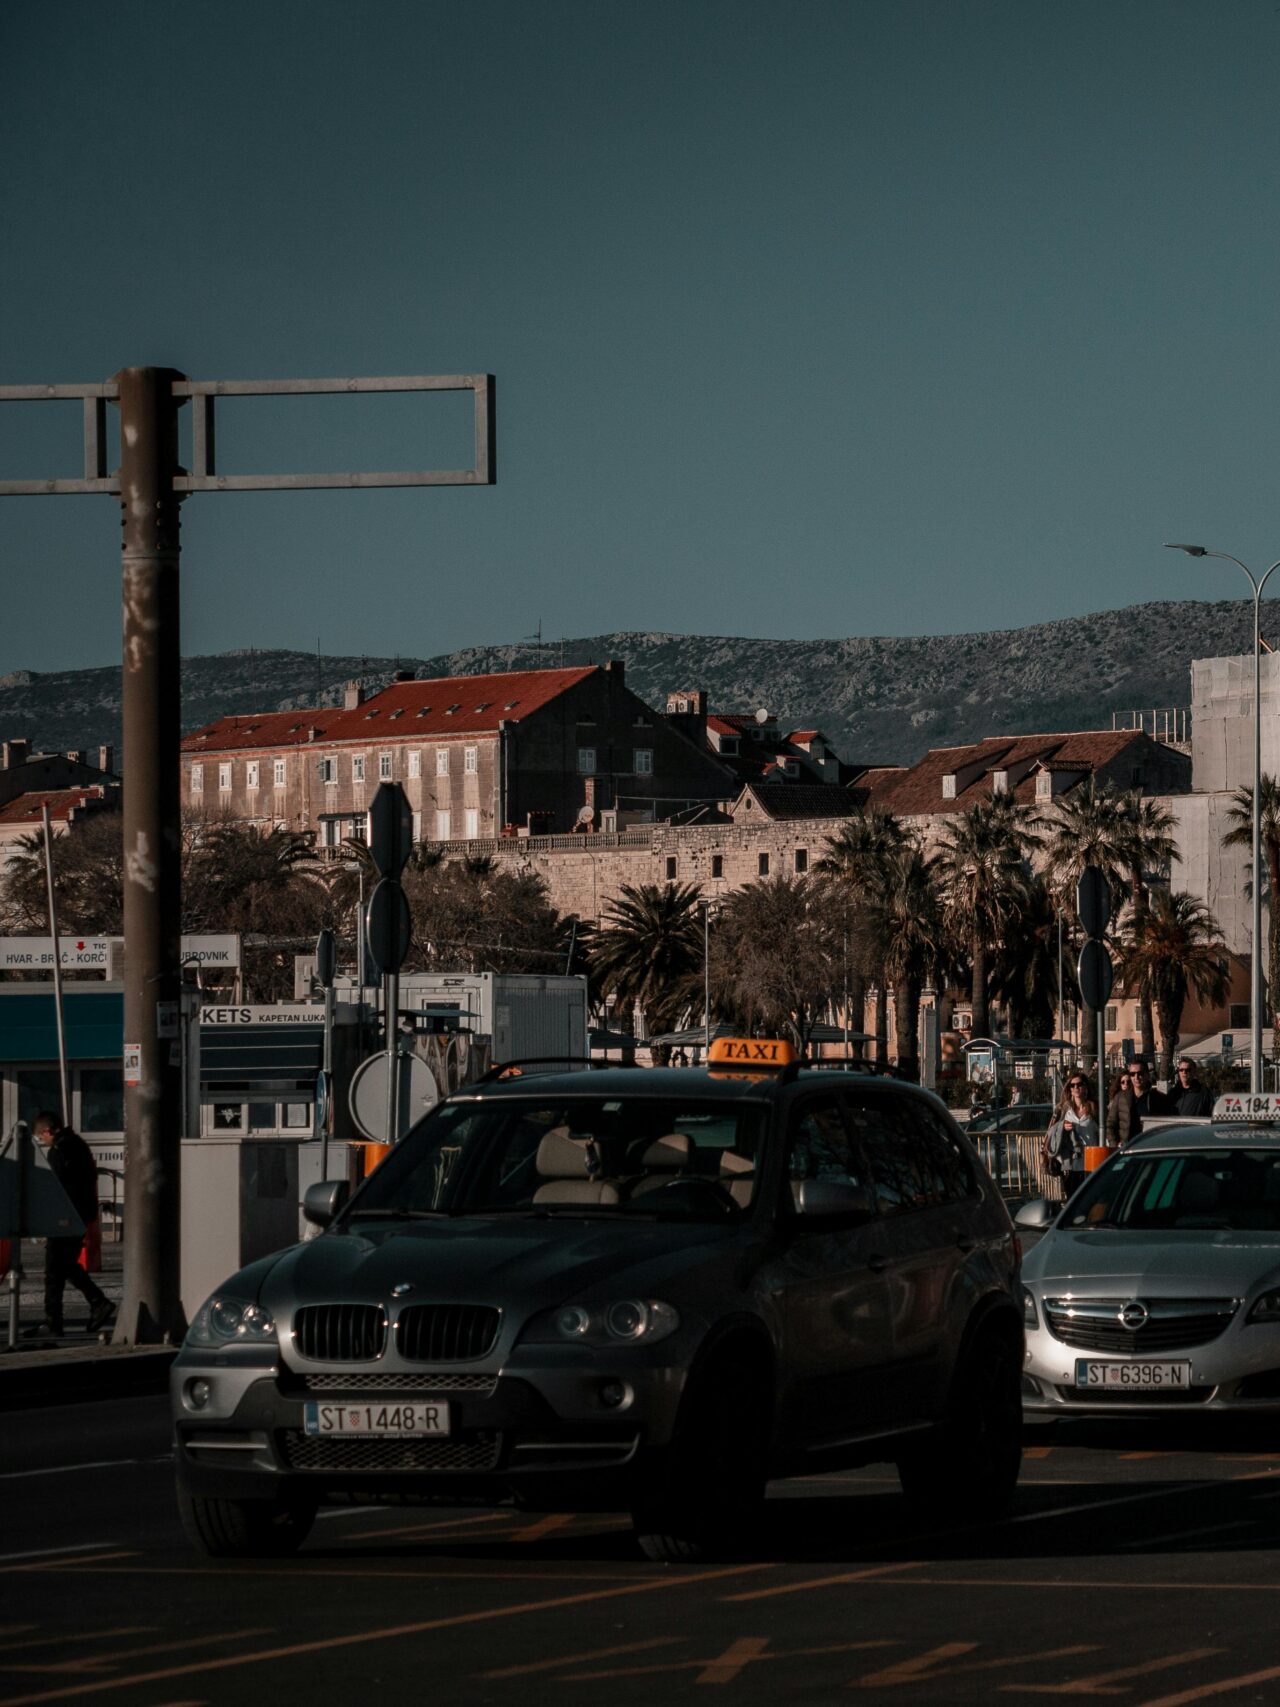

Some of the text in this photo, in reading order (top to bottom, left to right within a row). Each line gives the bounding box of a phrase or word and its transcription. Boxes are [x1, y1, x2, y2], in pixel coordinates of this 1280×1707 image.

[6, 954, 33, 963] HVAR
[41, 952, 68, 963] BRČ
[259, 1014, 300, 1022] KAPETAN
[723, 1042, 779, 1060] TAXI
[1245, 1097, 1270, 1113] 194
[1089, 1365, 1181, 1384] ST 6396-N
[321, 1406, 440, 1431] ST 1448-R
